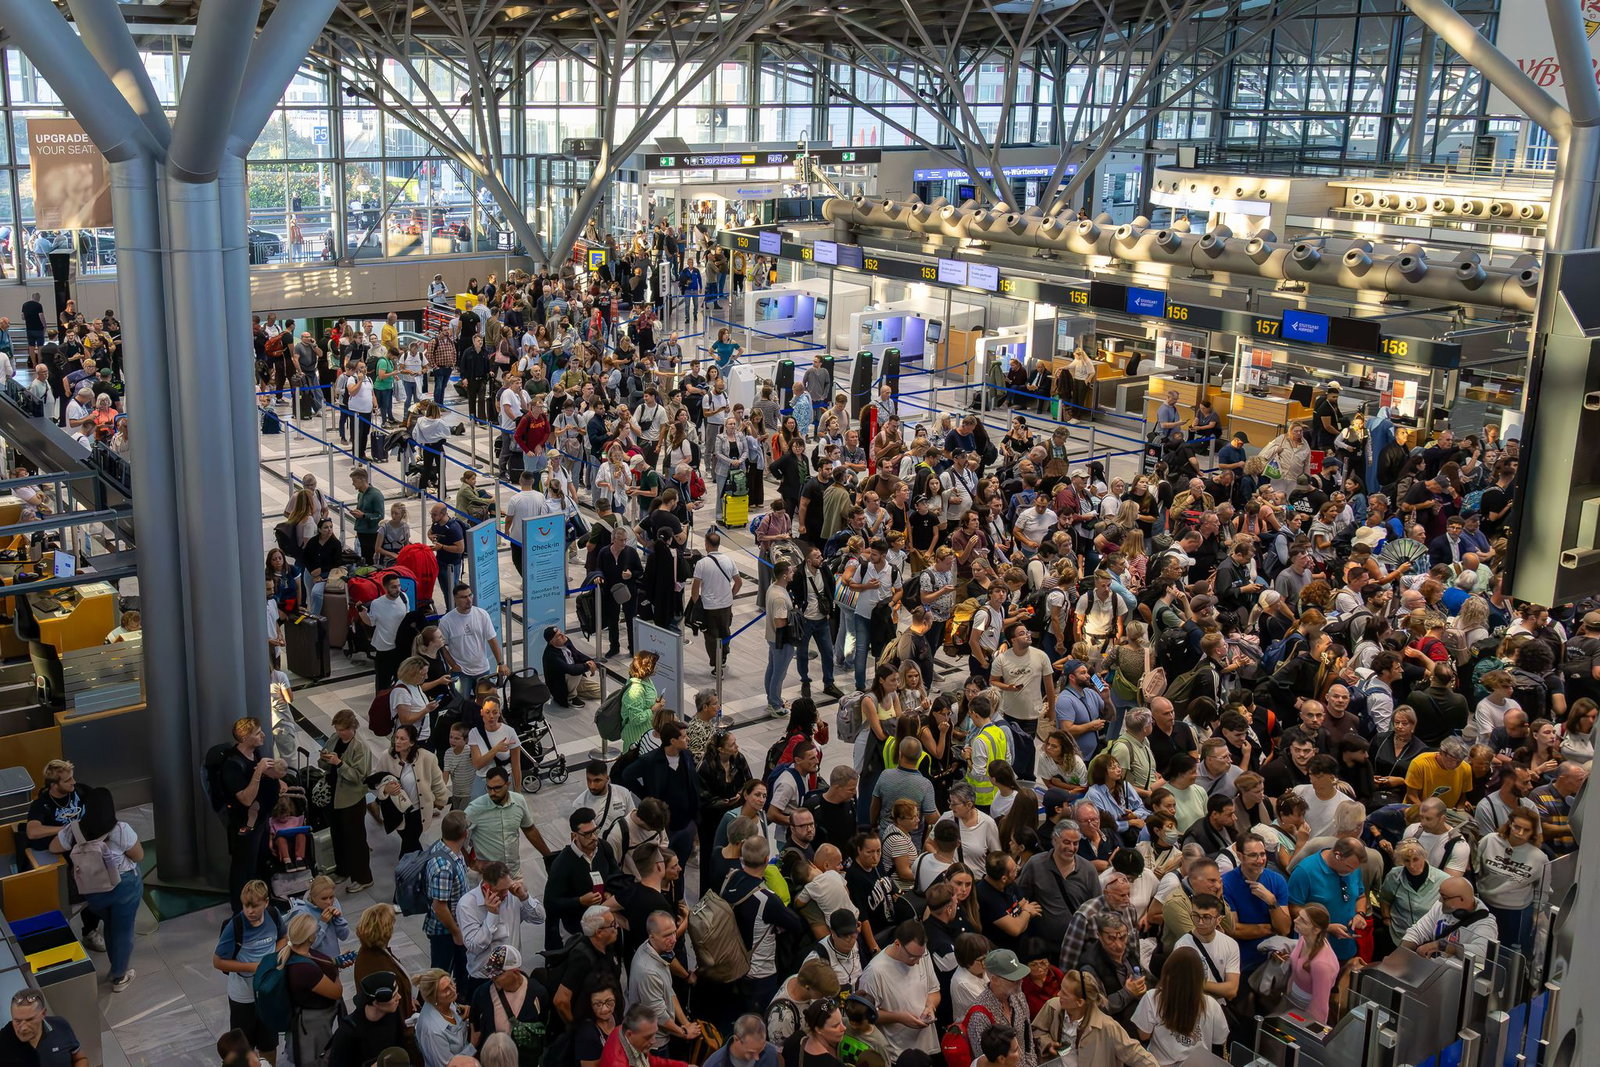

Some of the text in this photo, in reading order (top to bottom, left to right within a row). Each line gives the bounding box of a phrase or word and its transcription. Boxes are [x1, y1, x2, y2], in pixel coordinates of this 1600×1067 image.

[35, 134, 88, 143] UPGRADE
[314, 129, 328, 140] P5
[36, 145, 96, 155] YOUR SEAT.
[737, 237, 749, 248] 150
[801, 248, 813, 260] 151
[864, 258, 878, 270] 152
[921, 266, 937, 280] 153
[1000, 279, 1016, 292] 154
[1069, 290, 1088, 304] 155
[1167, 305, 1188, 321] 156
[1256, 319, 1279, 335] 157
[1381, 338, 1408, 356] 158
[1294, 504, 1313, 513] adidas
[531, 542, 560, 552] Check-in
[1494, 855, 1533, 872] snta
